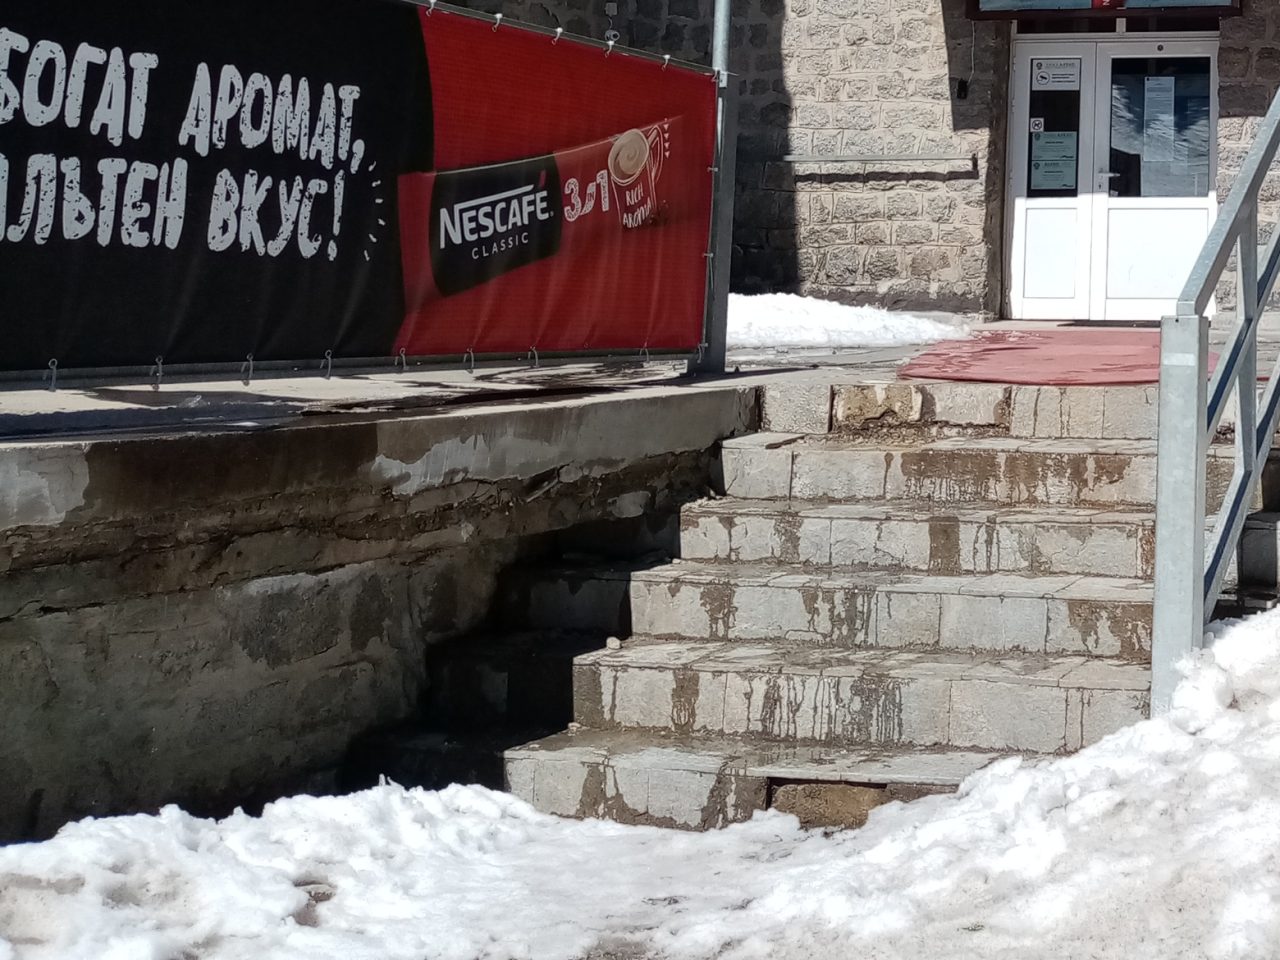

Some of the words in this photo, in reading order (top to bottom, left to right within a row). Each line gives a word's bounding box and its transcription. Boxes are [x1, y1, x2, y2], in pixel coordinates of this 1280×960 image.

[0, 26, 159, 147] БОГАТ
[178, 61, 366, 175] АРОМАТ,
[207, 167, 347, 262] ВКУС!
[625, 181, 645, 207] RICH
[471, 231, 530, 260] CLASSIC
